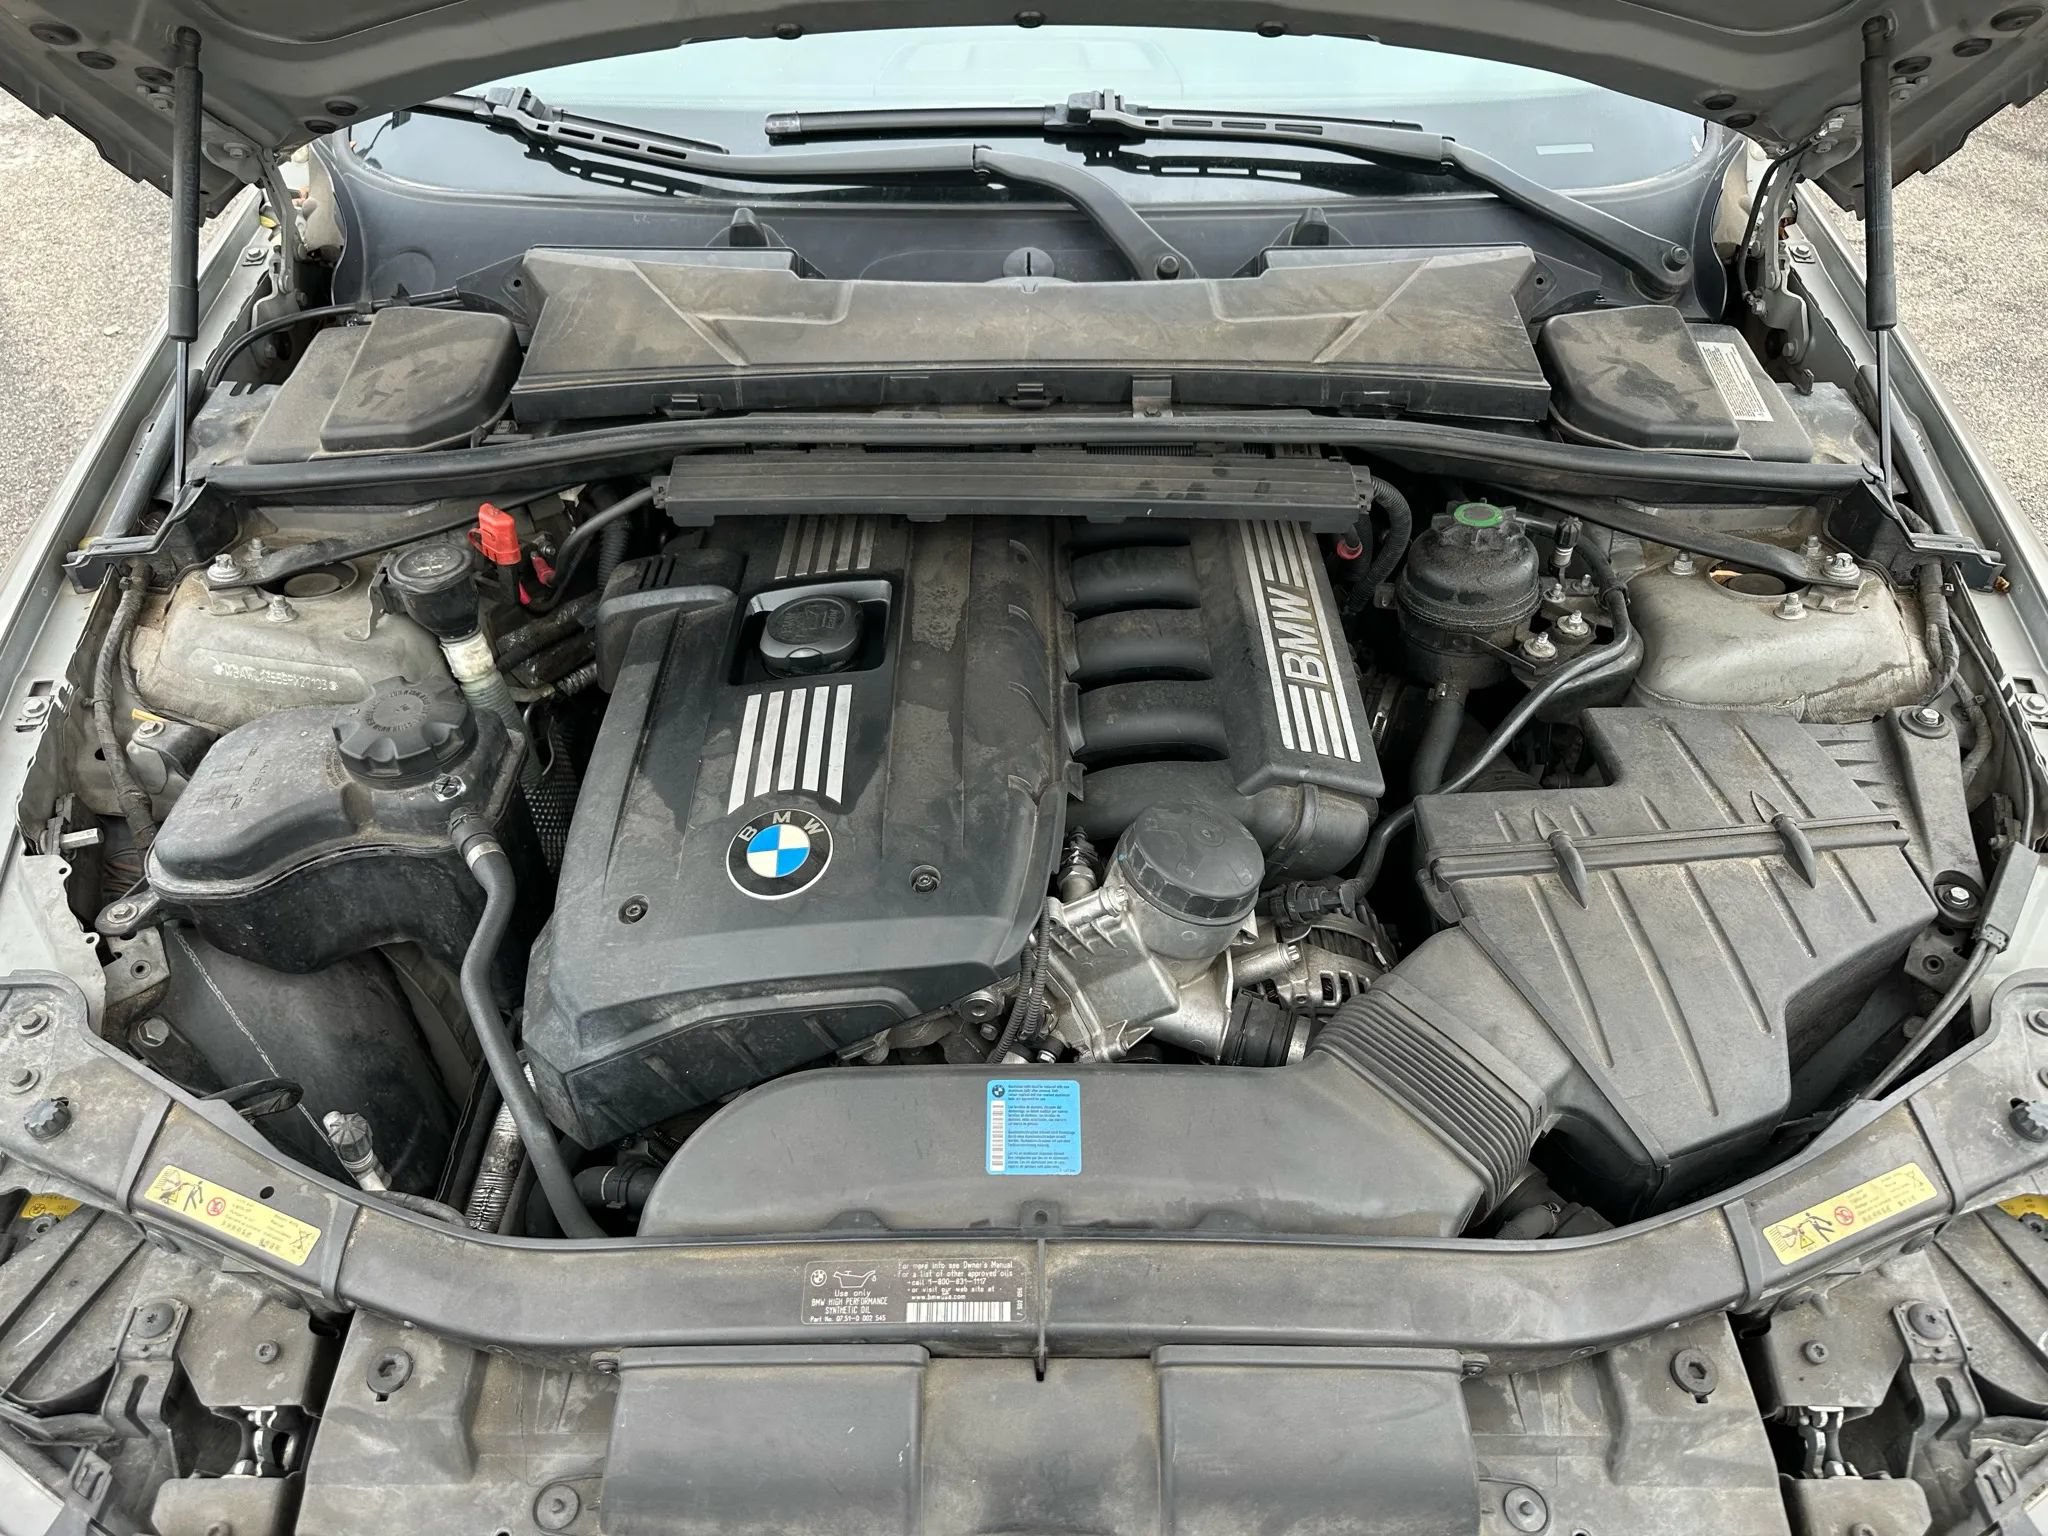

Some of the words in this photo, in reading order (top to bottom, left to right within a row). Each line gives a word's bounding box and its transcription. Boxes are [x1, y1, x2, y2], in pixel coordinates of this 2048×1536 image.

[1266, 586, 1329, 685] BMW
[738, 810, 824, 842] BMW
[932, 1261, 945, 1269] info
[963, 1261, 988, 1269] Owner's
[991, 1260, 1013, 1269] Manual
[920, 1269, 932, 1278] list
[935, 1269, 944, 1278] of
[946, 1269, 964, 1278] other
[967, 1269, 997, 1279] approved
[1000, 1269, 1013, 1279] oils
[927, 1277, 987, 1285] 1-800-831-1117
[834, 1289, 849, 1297] Use
[853, 1288, 872, 1298] only
[955, 1285, 969, 1293] web
[971, 1285, 985, 1293] site
[987, 1285, 995, 1293] at
[811, 1298, 826, 1307] BMW
[828, 1297, 843, 1306] HIGH
[845, 1296, 888, 1306] PERFORMANCE
[824, 1306, 858, 1315] SYNTHETIC
[860, 1305, 872, 1314] OIL
[809, 1315, 822, 1323] Part
